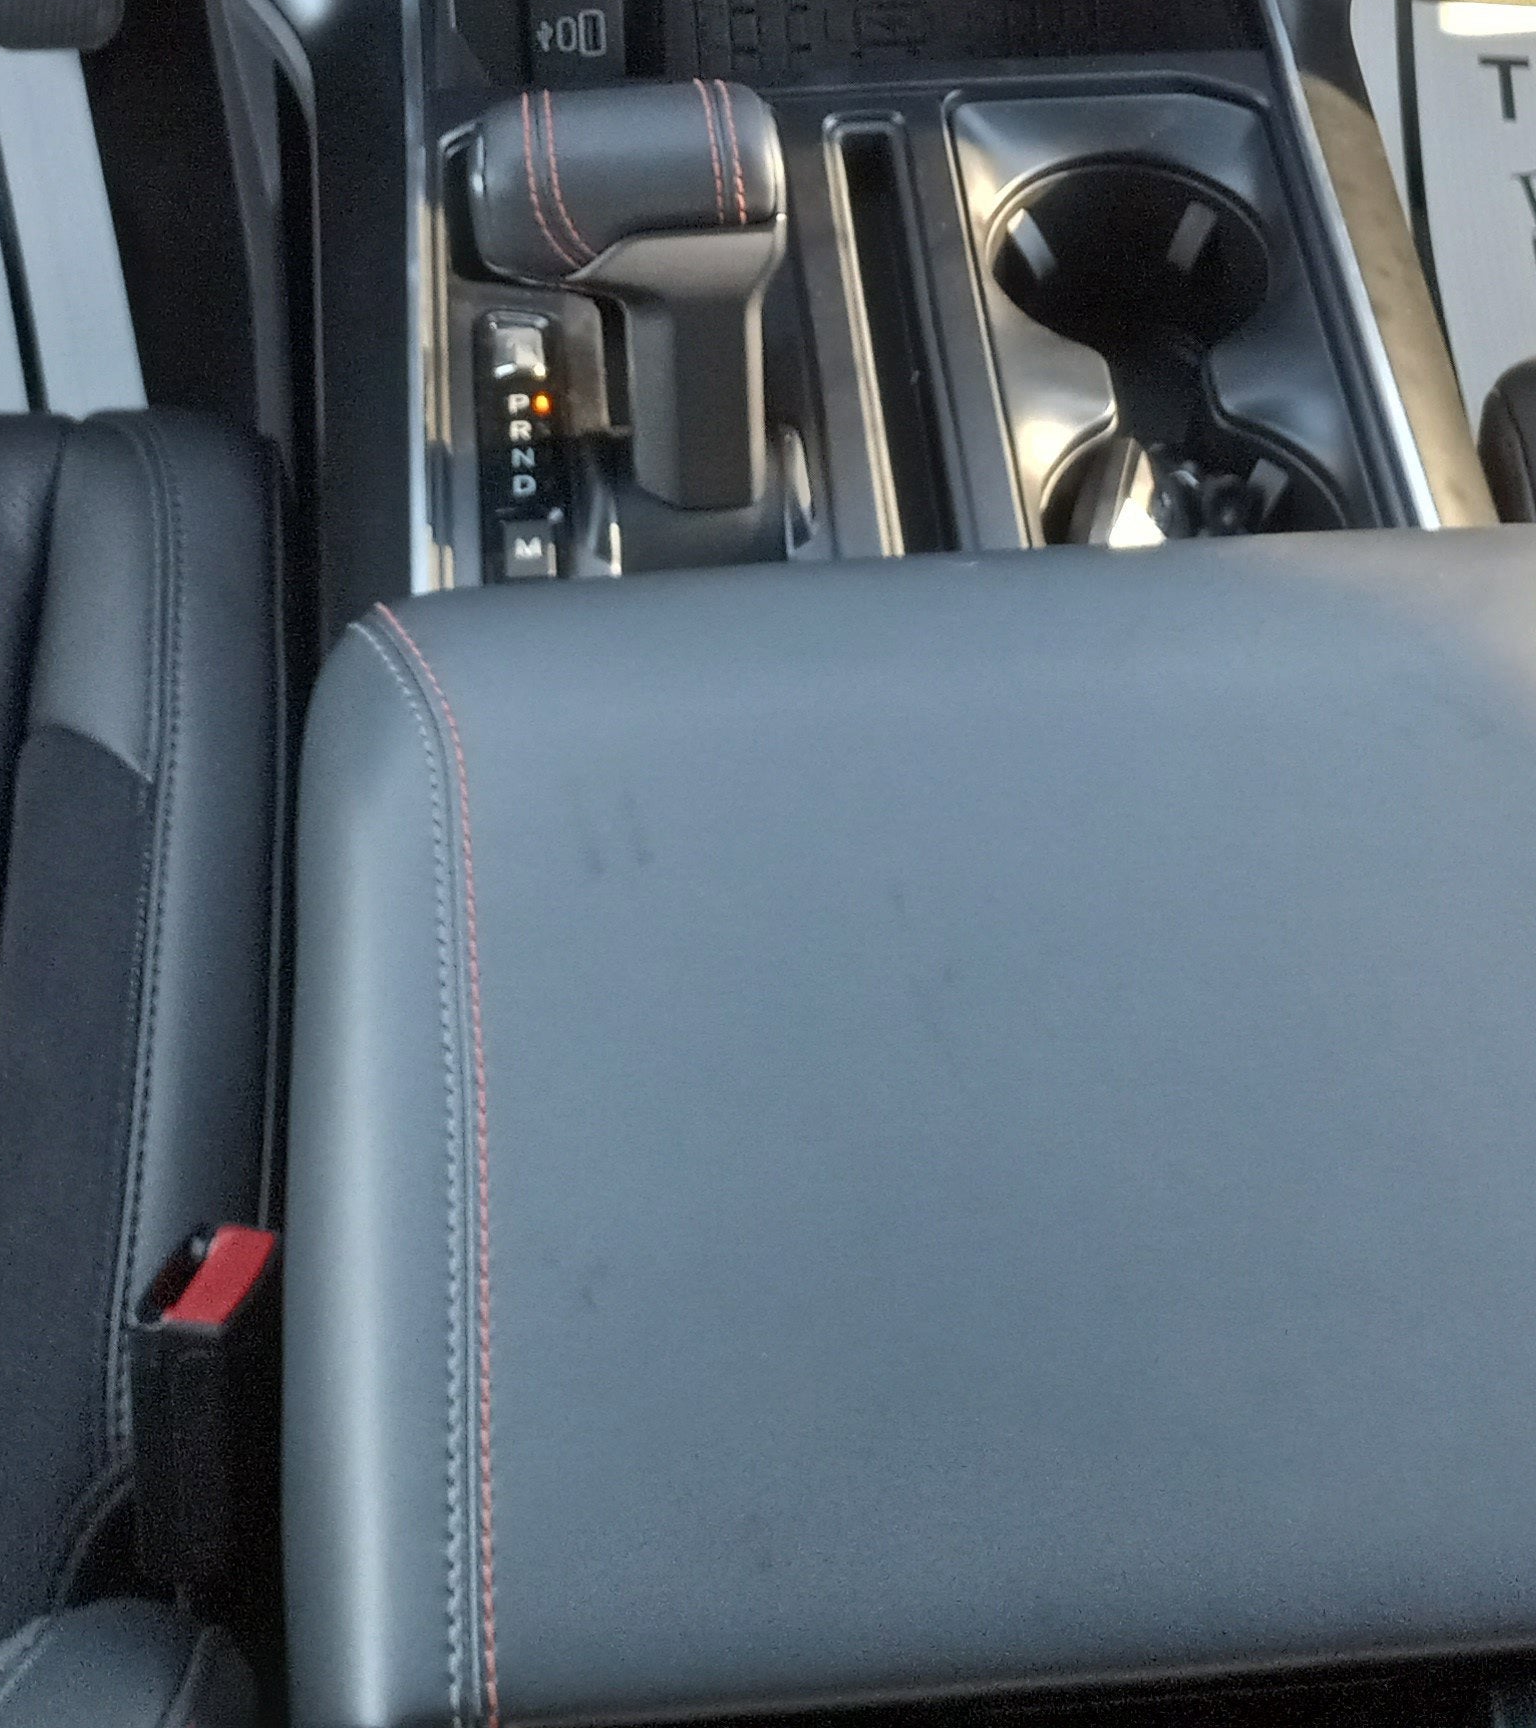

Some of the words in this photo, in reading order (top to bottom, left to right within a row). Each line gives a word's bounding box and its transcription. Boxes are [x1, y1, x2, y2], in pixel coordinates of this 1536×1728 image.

[507, 393, 530, 415] P
[509, 420, 533, 442] R
[511, 447, 536, 469] N
[512, 474, 537, 497] D
[514, 537, 542, 560] M
